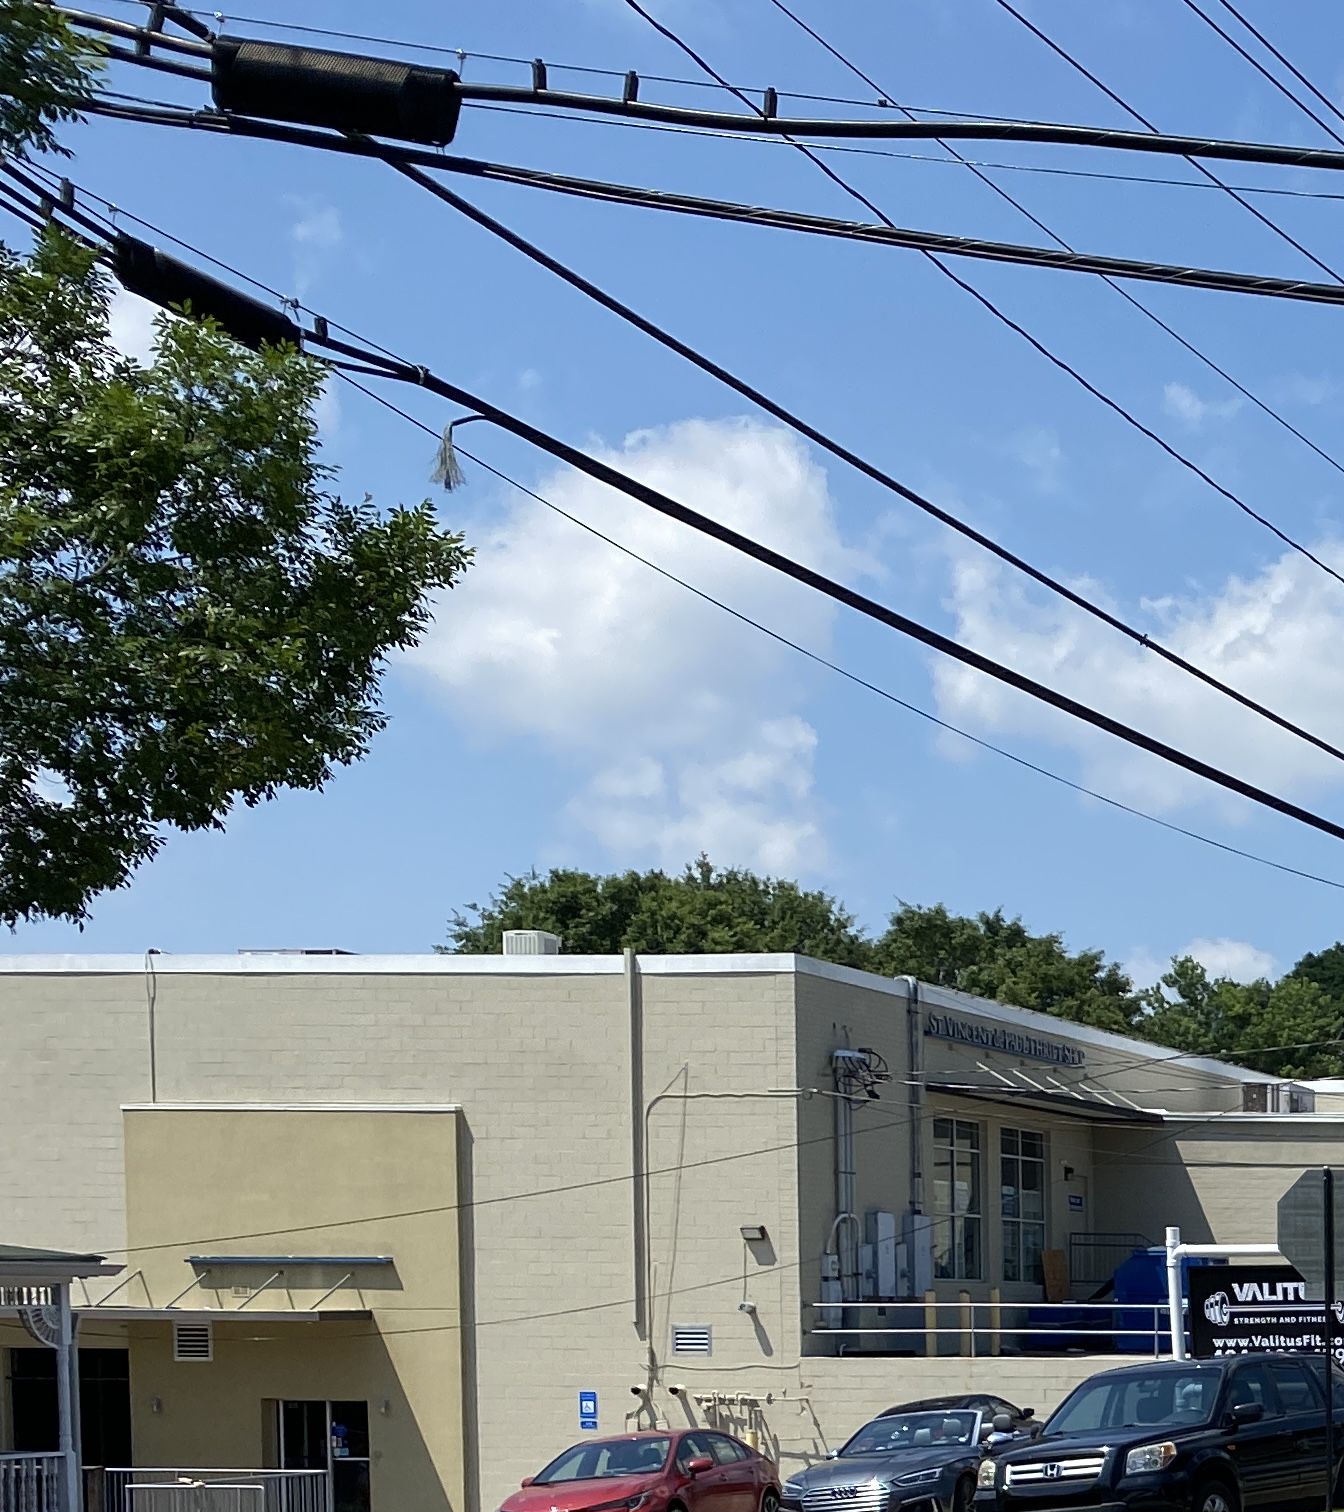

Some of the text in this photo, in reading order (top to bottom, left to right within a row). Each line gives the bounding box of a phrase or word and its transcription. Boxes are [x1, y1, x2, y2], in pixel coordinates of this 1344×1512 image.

[1231, 1282, 1305, 1302] VALIT
[1233, 1315, 1327, 1325] STRENGTH AND FITNE
